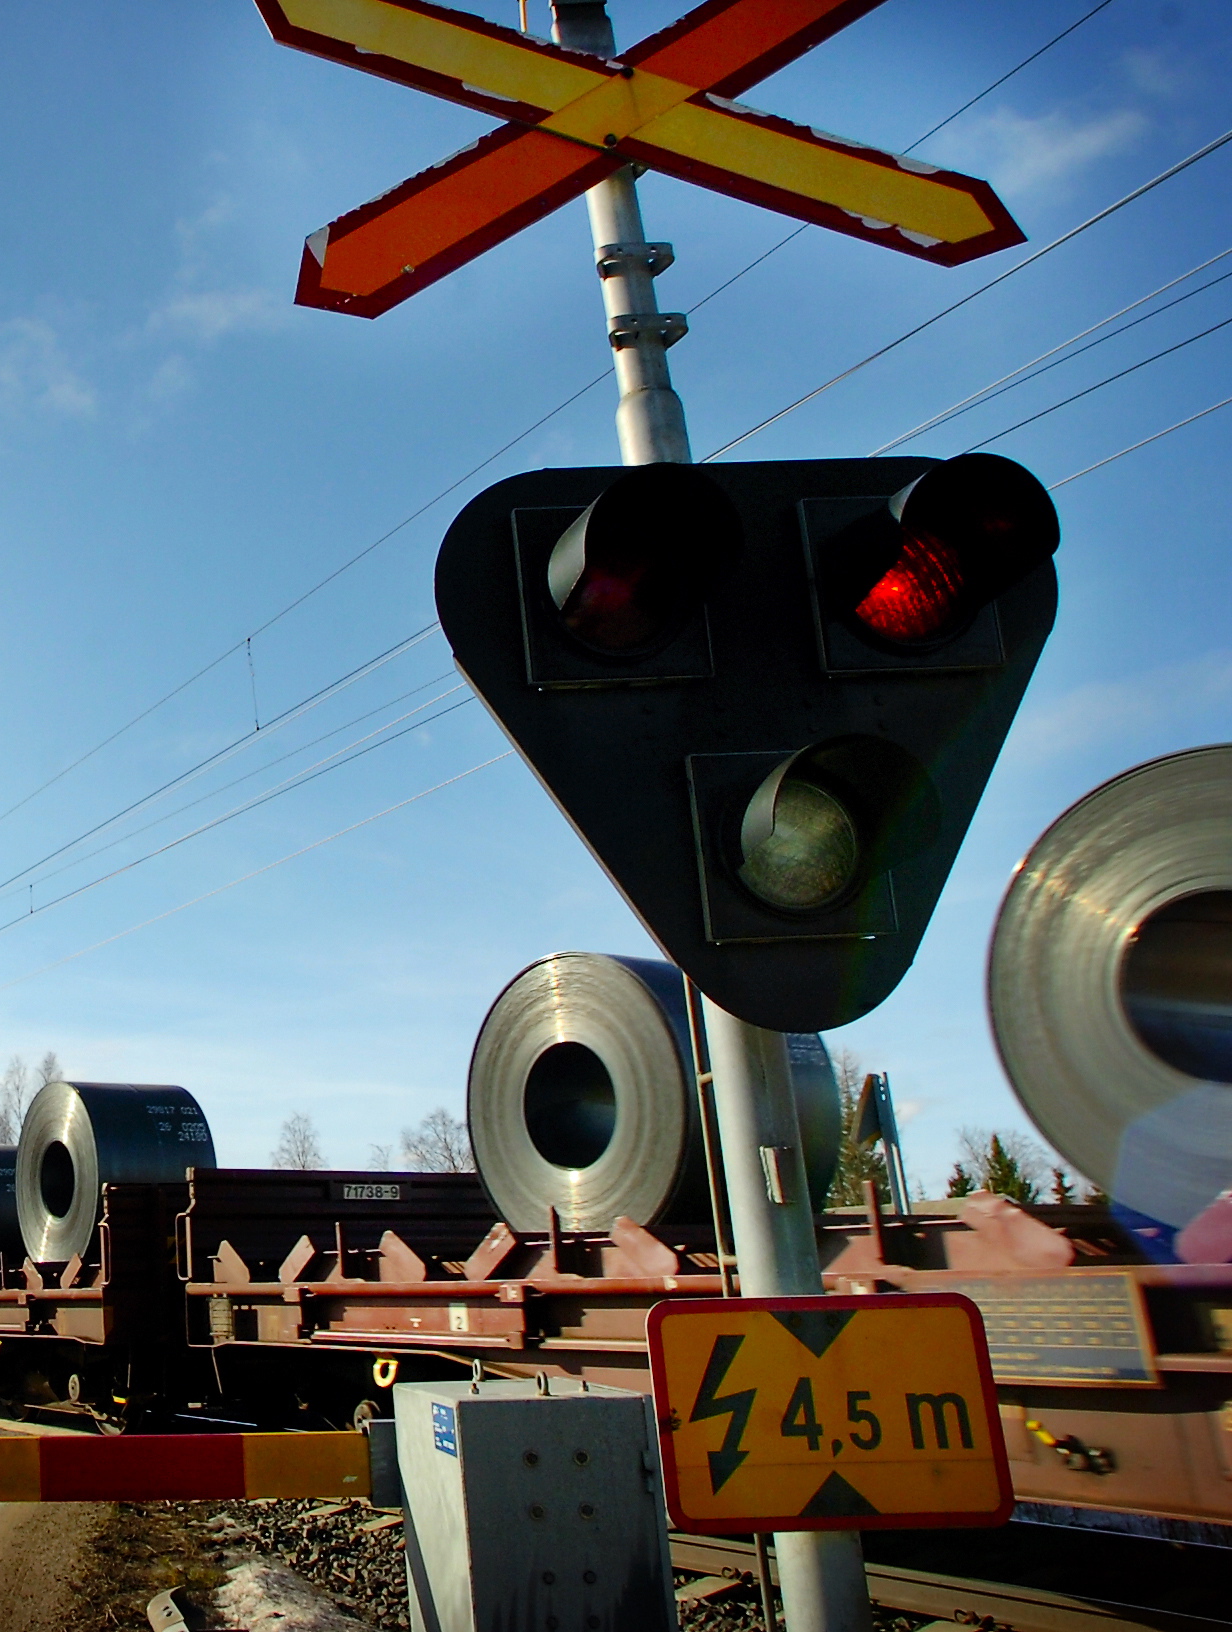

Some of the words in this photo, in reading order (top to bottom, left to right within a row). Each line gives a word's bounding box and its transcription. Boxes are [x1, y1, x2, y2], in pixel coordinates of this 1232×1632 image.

[345, 1186, 398, 1198] 71738-9
[456, 1316, 463, 1330] 2
[780, 1377, 882, 1457] 4,5
[905, 1392, 974, 1449] m
